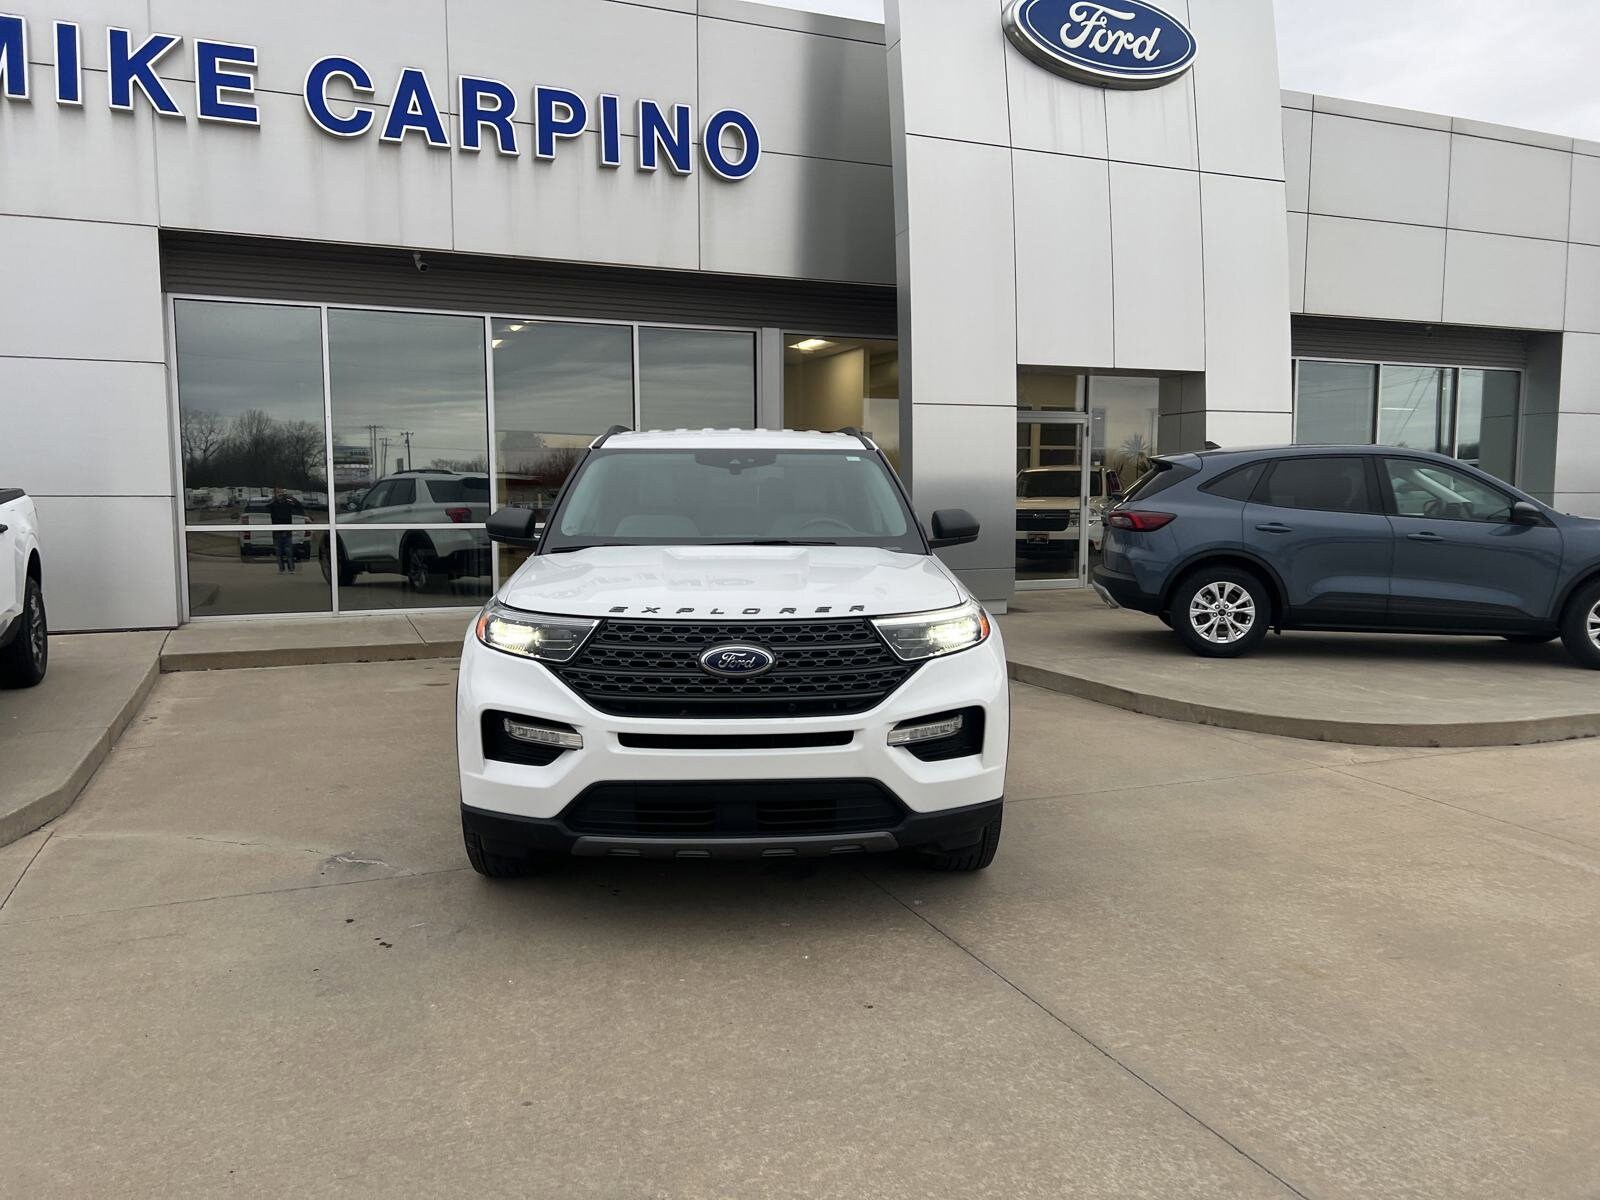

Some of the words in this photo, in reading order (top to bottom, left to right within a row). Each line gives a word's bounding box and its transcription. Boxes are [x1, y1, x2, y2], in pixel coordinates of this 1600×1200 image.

[1059, 1, 1162, 62] Ford
[303, 55, 762, 181] CARPINO
[608, 604, 866, 616] EXPLORER
[718, 652, 756, 668] Ford
